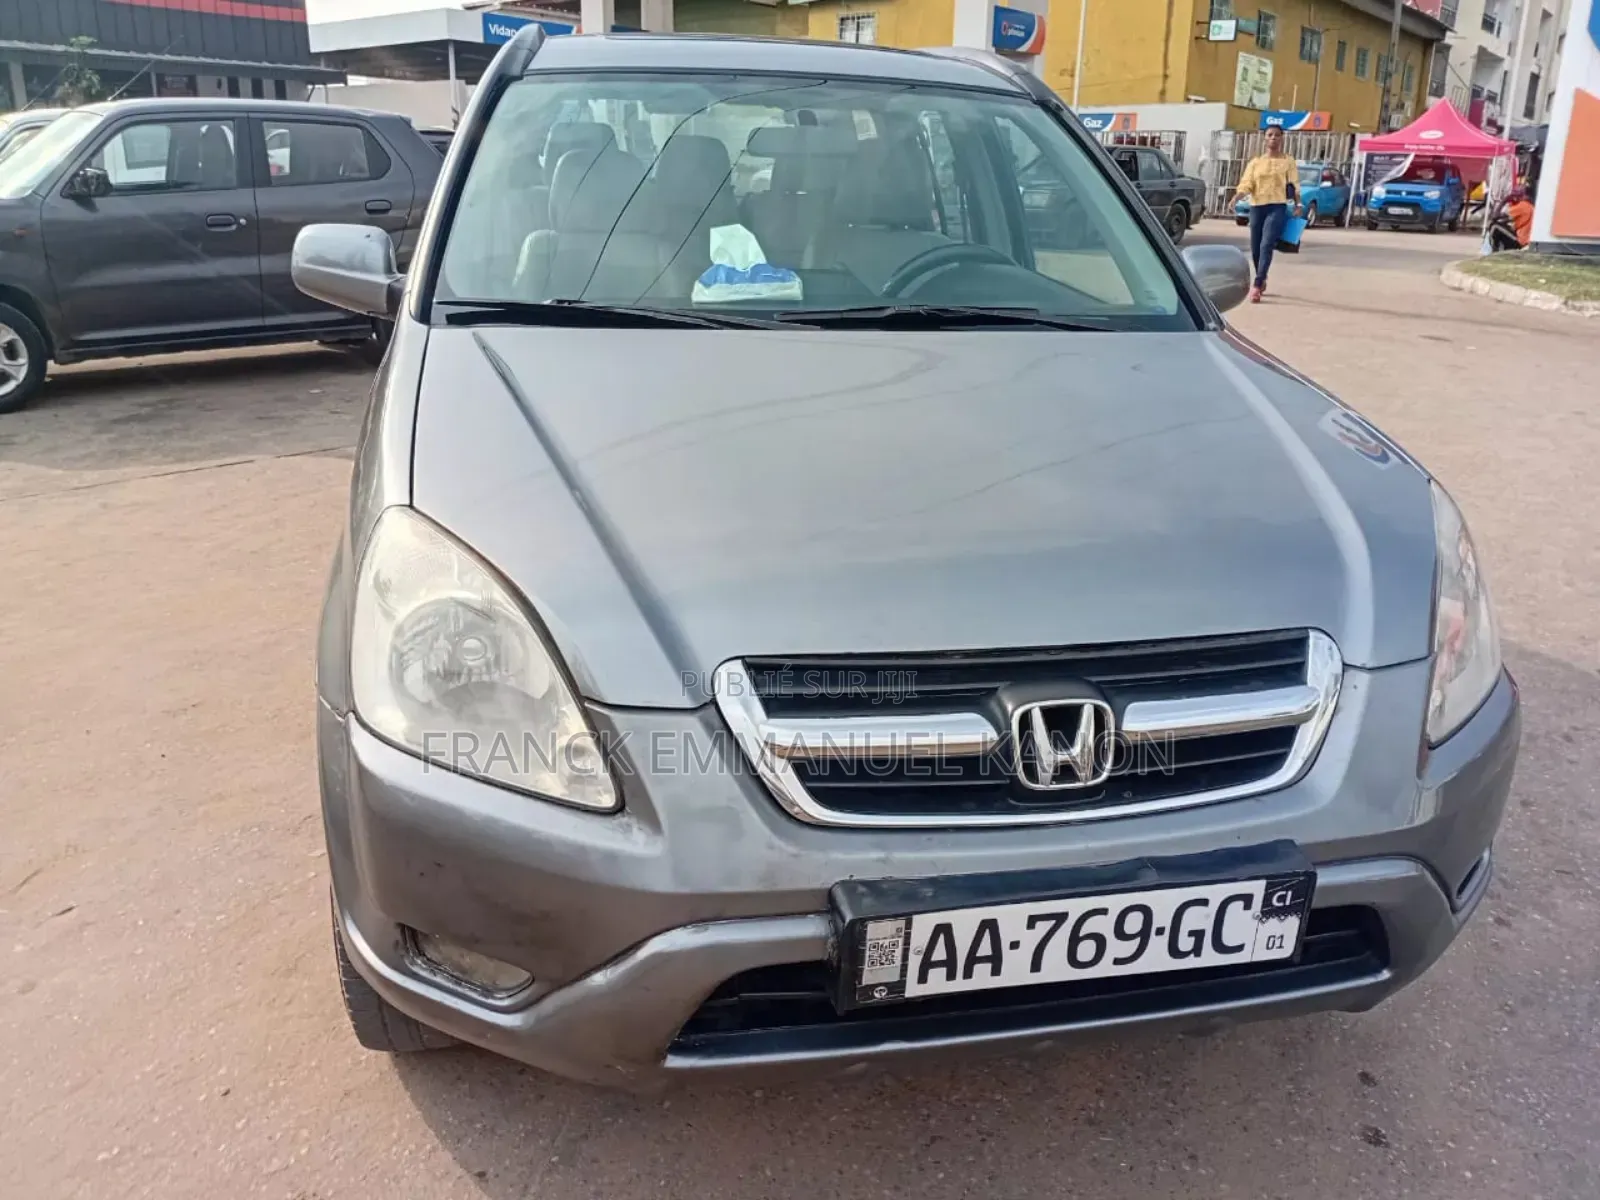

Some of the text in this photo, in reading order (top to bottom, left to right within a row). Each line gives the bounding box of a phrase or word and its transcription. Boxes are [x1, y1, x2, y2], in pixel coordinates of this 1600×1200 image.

[1083, 116, 1103, 128] Gaz
[1266, 115, 1284, 125] Gaz
[1271, 890, 1293, 907] CI
[1265, 934, 1285, 951] 01
